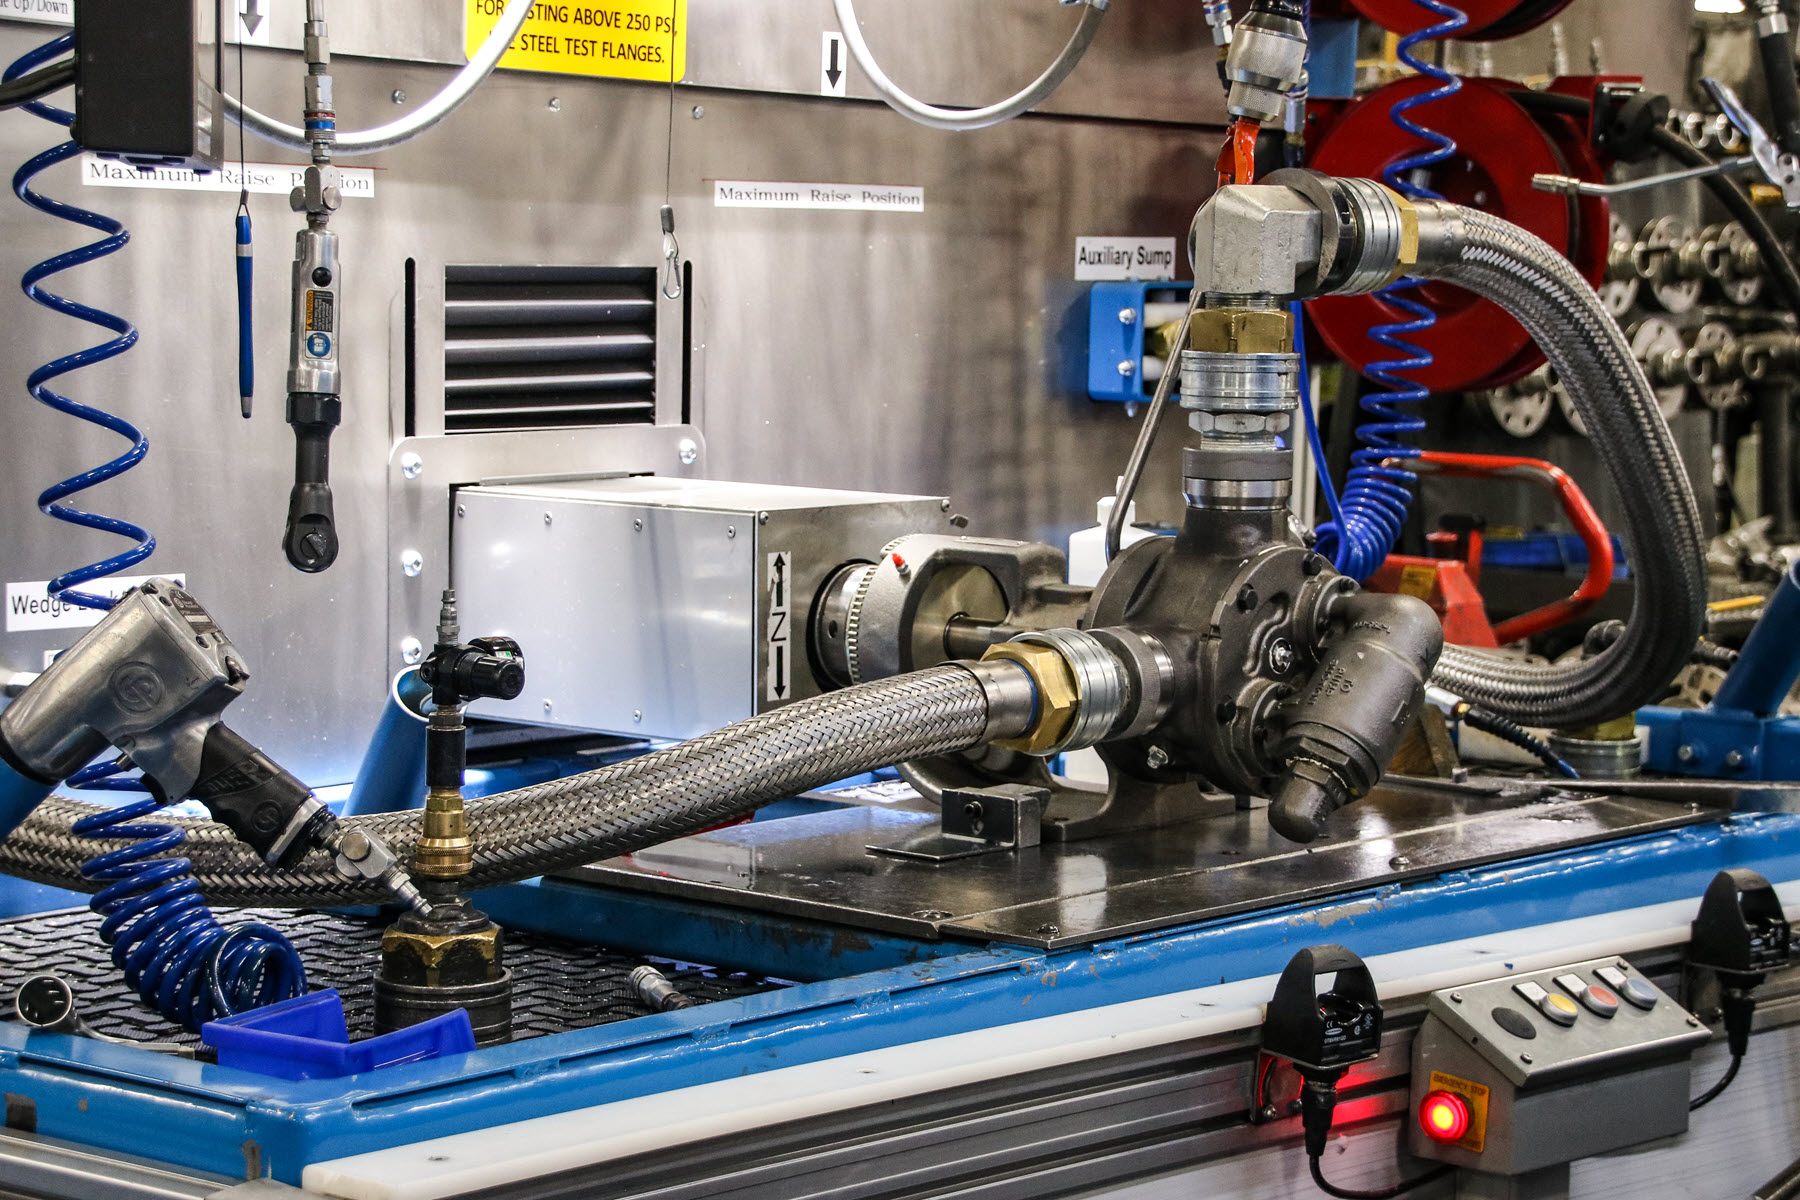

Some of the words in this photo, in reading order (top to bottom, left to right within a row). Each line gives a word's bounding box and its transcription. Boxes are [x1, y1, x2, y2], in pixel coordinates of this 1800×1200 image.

[476, 0, 505, 16] FOR
[527, 3, 569, 23] STING
[573, 8, 622, 29] ABOVE
[626, 13, 651, 32] 250
[520, 33, 560, 54] STEEL
[564, 38, 598, 57] TEST
[601, 42, 665, 64] FLANGES.
[219, 169, 276, 187] Raise
[290, 172, 370, 190] Pion
[719, 187, 800, 201] Maximum
[810, 189, 852, 203] Raise
[861, 190, 921, 205] Position
[1078, 245, 1133, 270] Auxiliary
[1137, 245, 1173, 270] Sump
[11, 594, 72, 618] Wedge
